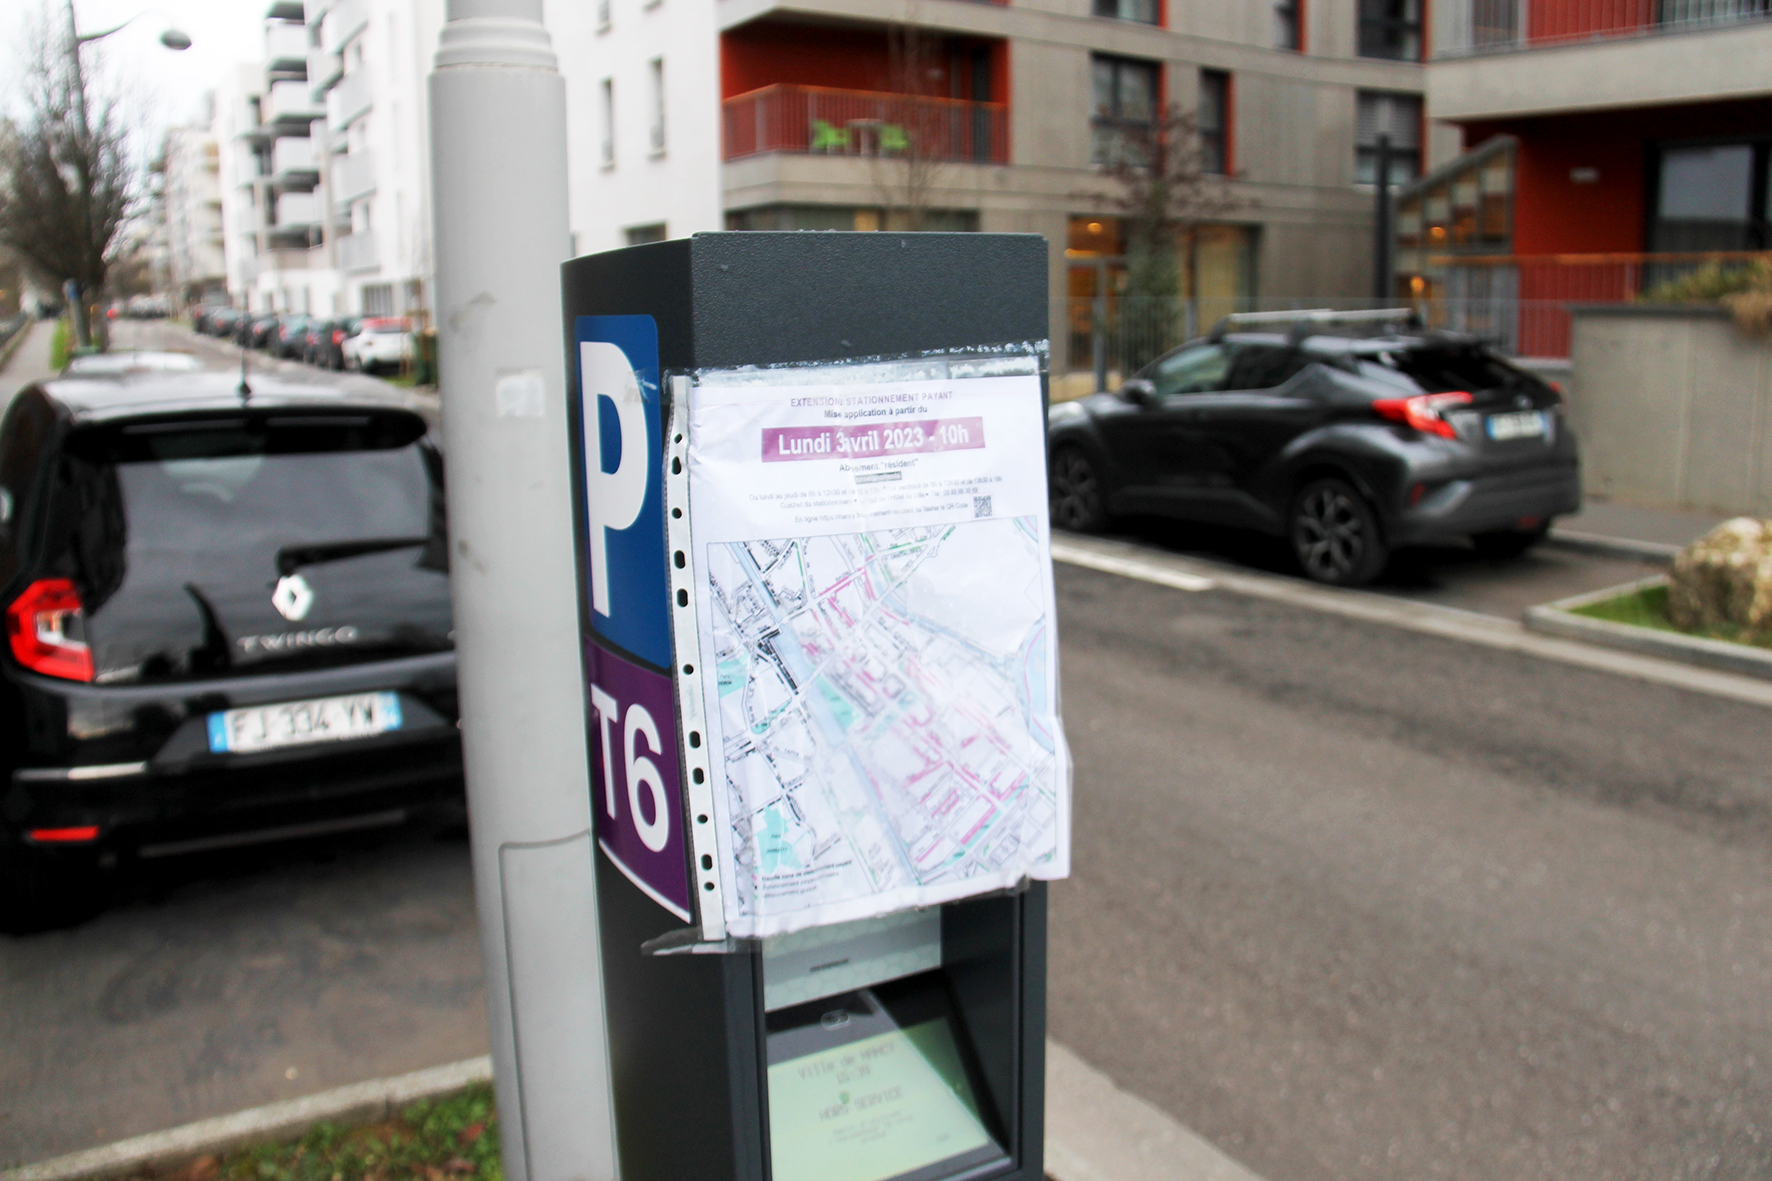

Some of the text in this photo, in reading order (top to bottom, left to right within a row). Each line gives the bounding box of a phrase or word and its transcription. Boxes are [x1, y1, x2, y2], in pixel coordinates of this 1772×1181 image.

[844, 408, 886, 419] application
[895, 406, 915, 416] partir
[918, 405, 928, 413] du
[846, 393, 919, 406] STATIONNEMENT
[922, 391, 953, 401] PAYANT
[778, 432, 831, 455] Lundi
[884, 427, 923, 449] 2023
[940, 425, 969, 444] 10h
[580, 341, 649, 617] P
[236, 625, 358, 653] TWINGO
[590, 683, 669, 852] T6
